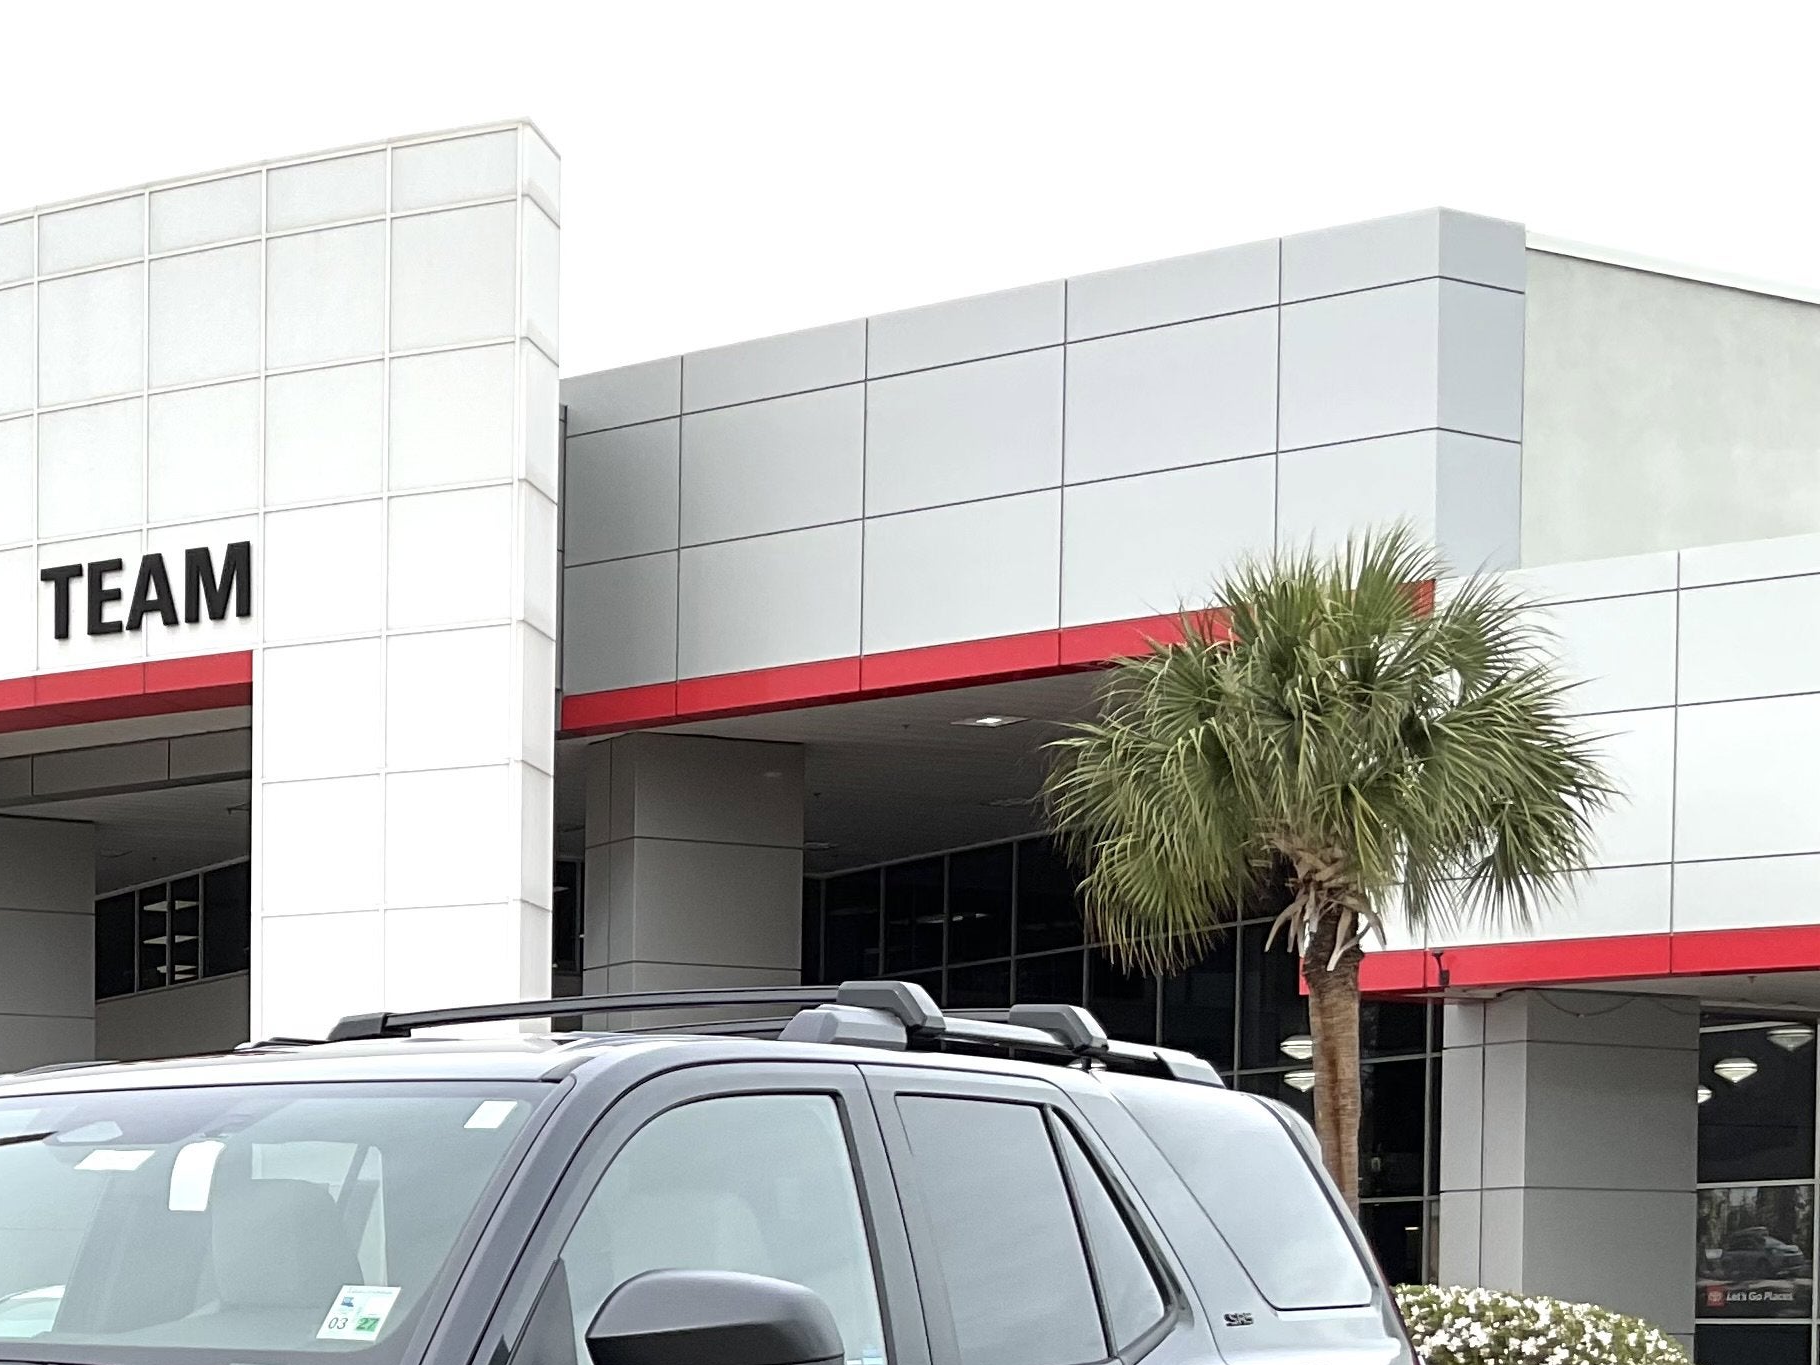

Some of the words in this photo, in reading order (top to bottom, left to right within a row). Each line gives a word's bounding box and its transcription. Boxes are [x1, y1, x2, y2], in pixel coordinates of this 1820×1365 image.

[41, 541, 251, 639] TEAM
[328, 1317, 349, 1330] 03
[355, 1317, 381, 1331] 27
